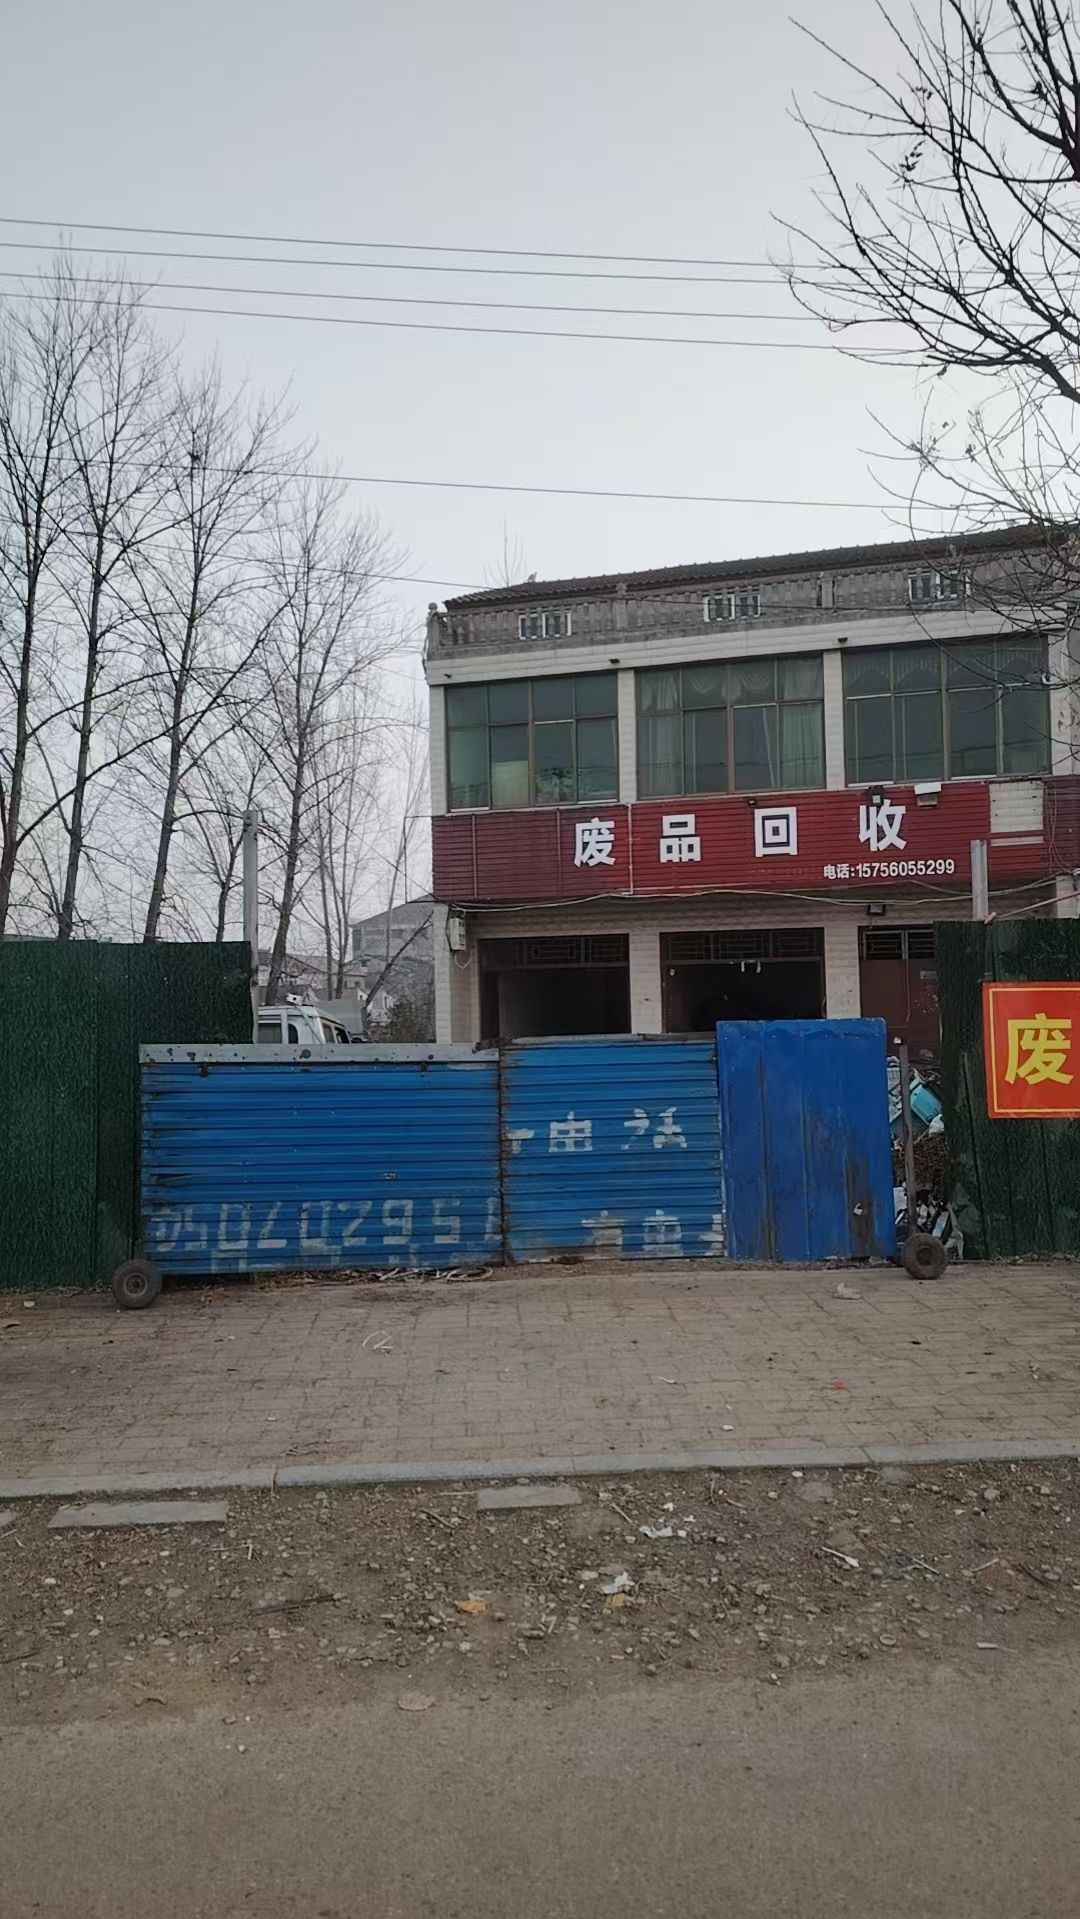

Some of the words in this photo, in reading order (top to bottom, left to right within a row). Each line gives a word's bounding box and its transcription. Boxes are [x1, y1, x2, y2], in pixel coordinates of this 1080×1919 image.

[574, 799, 907, 867] 废品回收
[823, 859, 955, 879] 电话:15756055299
[1004, 1012, 1074, 1085] 废
